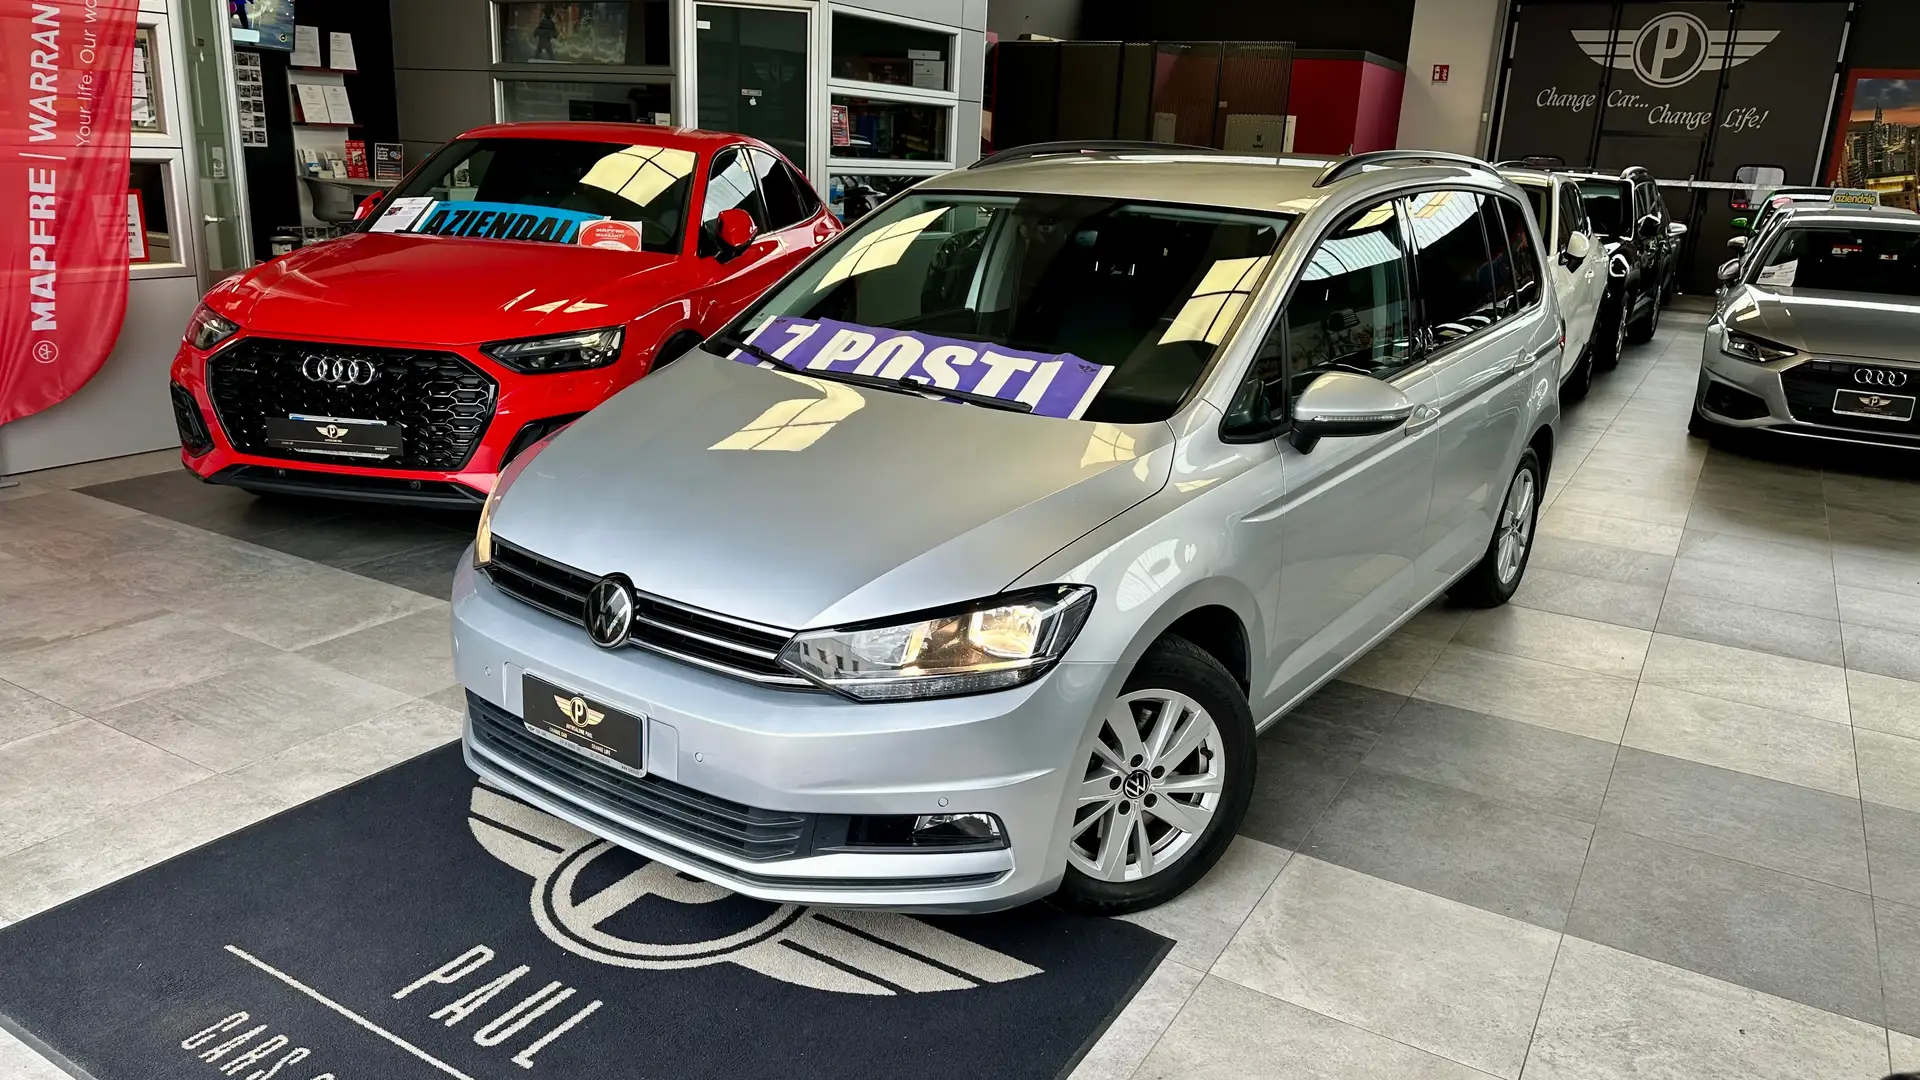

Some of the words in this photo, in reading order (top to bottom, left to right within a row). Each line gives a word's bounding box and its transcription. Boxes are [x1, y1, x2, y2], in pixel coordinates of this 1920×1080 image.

[80, 29, 97, 64] Our
[29, 3, 60, 142] WARRAN
[77, 70, 92, 101] life.
[1536, 86, 1596, 112] Change
[1606, 89, 1649, 108] Car...
[1648, 103, 1712, 131] Change
[1720, 106, 1769, 133] Life!
[76, 105, 92, 147] Your
[1835, 192, 1877, 205] aziendale
[421, 209, 579, 244] AZIENDAL
[29, 168, 56, 331] MAPFRE
[760, 322, 822, 370] 7
[806, 327, 1063, 413] POSTI
[391, 944, 604, 1070] PAUL
[181, 1010, 312, 1080] CARS
